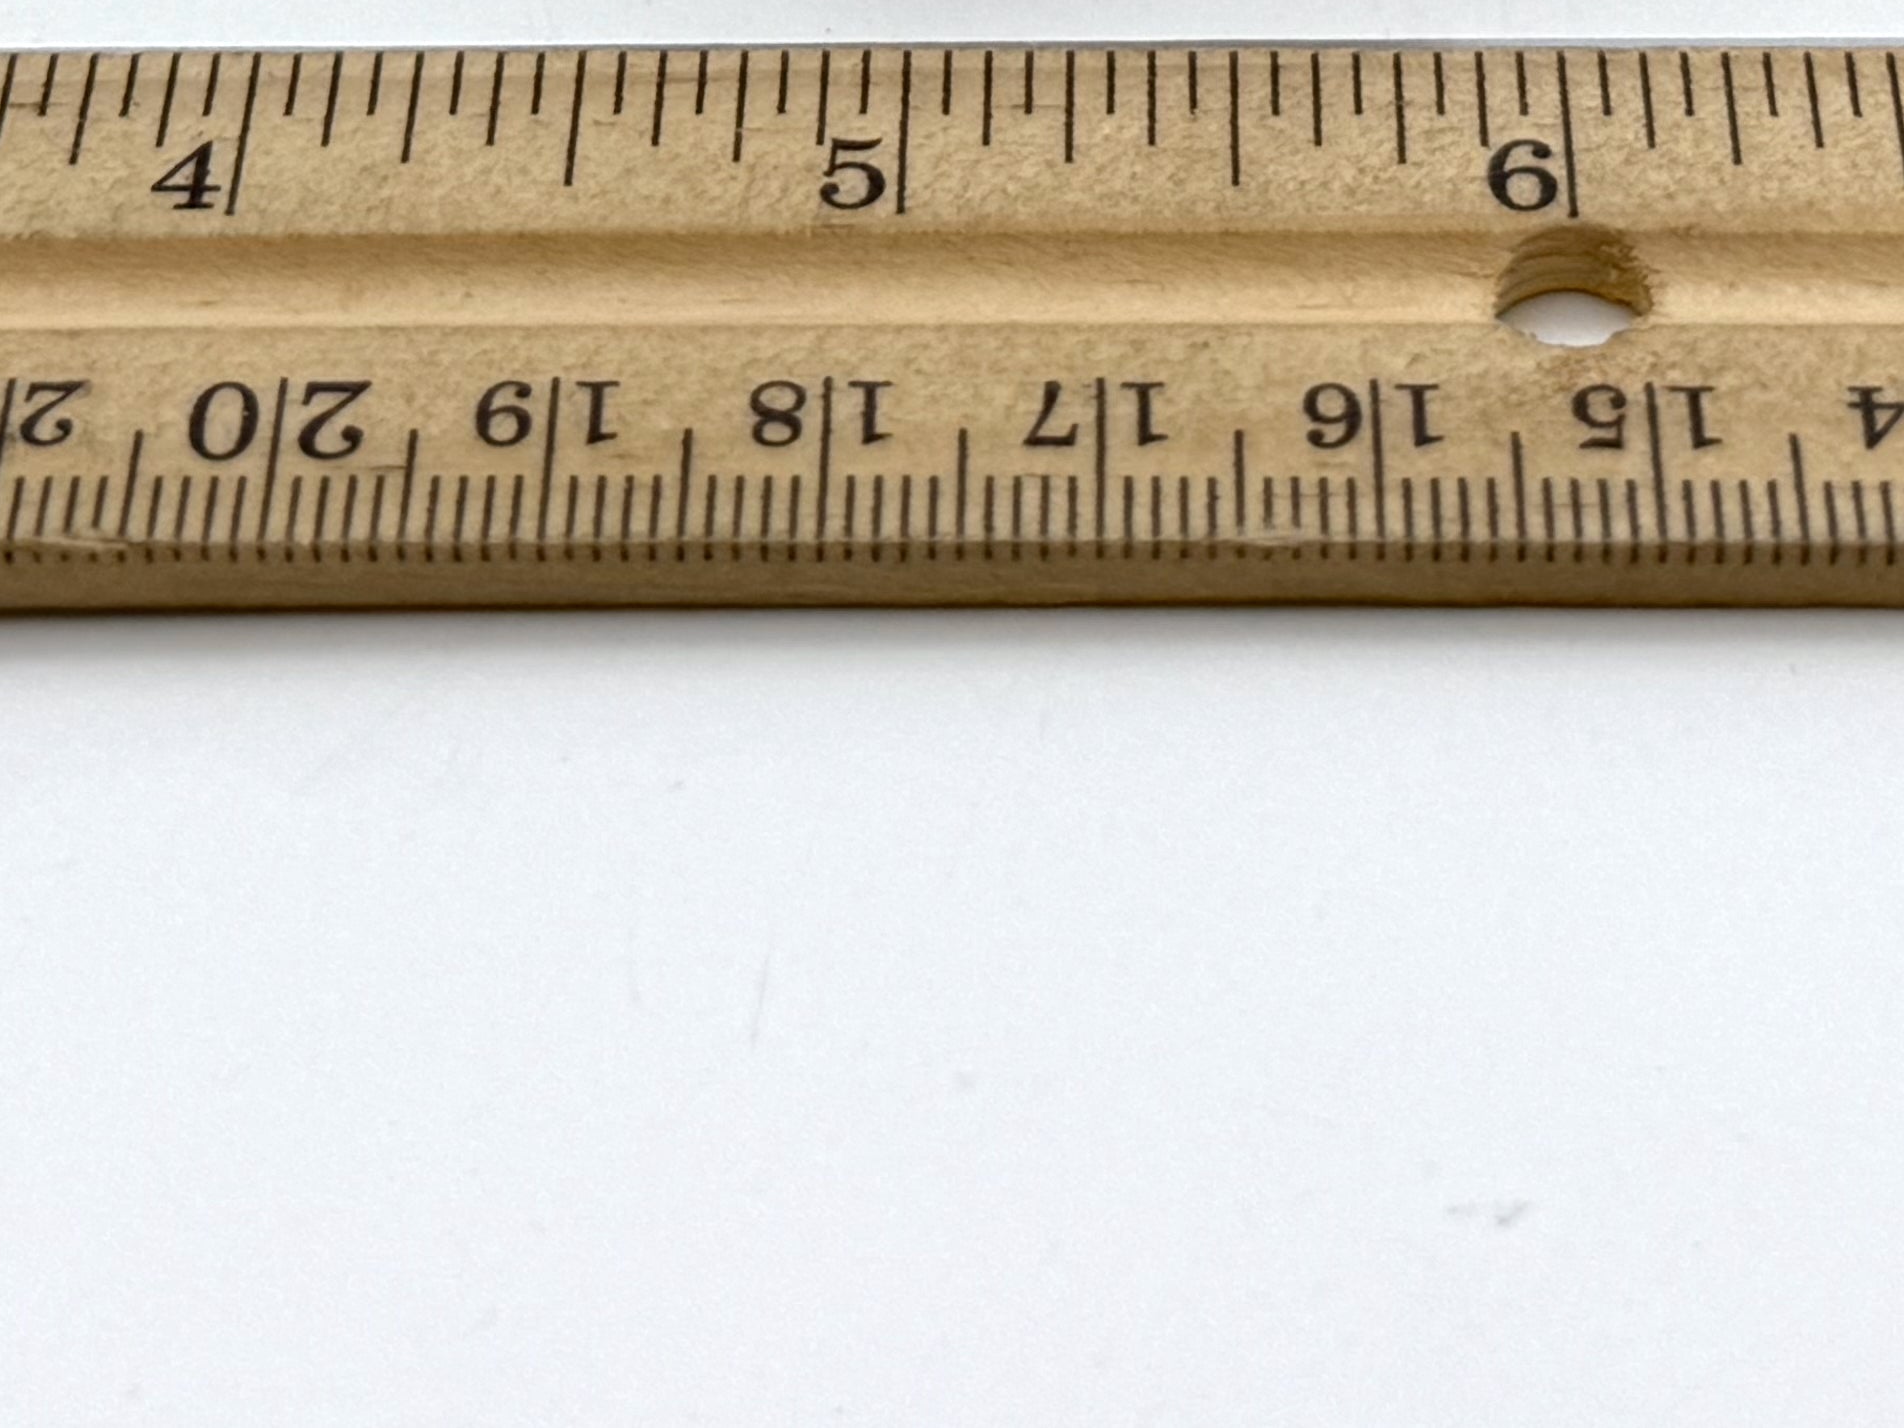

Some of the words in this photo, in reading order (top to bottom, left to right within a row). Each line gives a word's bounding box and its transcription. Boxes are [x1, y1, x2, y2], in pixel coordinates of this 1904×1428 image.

[149, 141, 223, 211] 4
[818, 139, 888, 210] 5
[1487, 139, 1558, 212] 6
[187, 380, 373, 461] 20
[475, 380, 621, 447] 19
[749, 380, 894, 447] 18
[1022, 380, 1169, 447] 17
[1302, 382, 1444, 450] 16
[1570, 383, 1723, 452] 15
